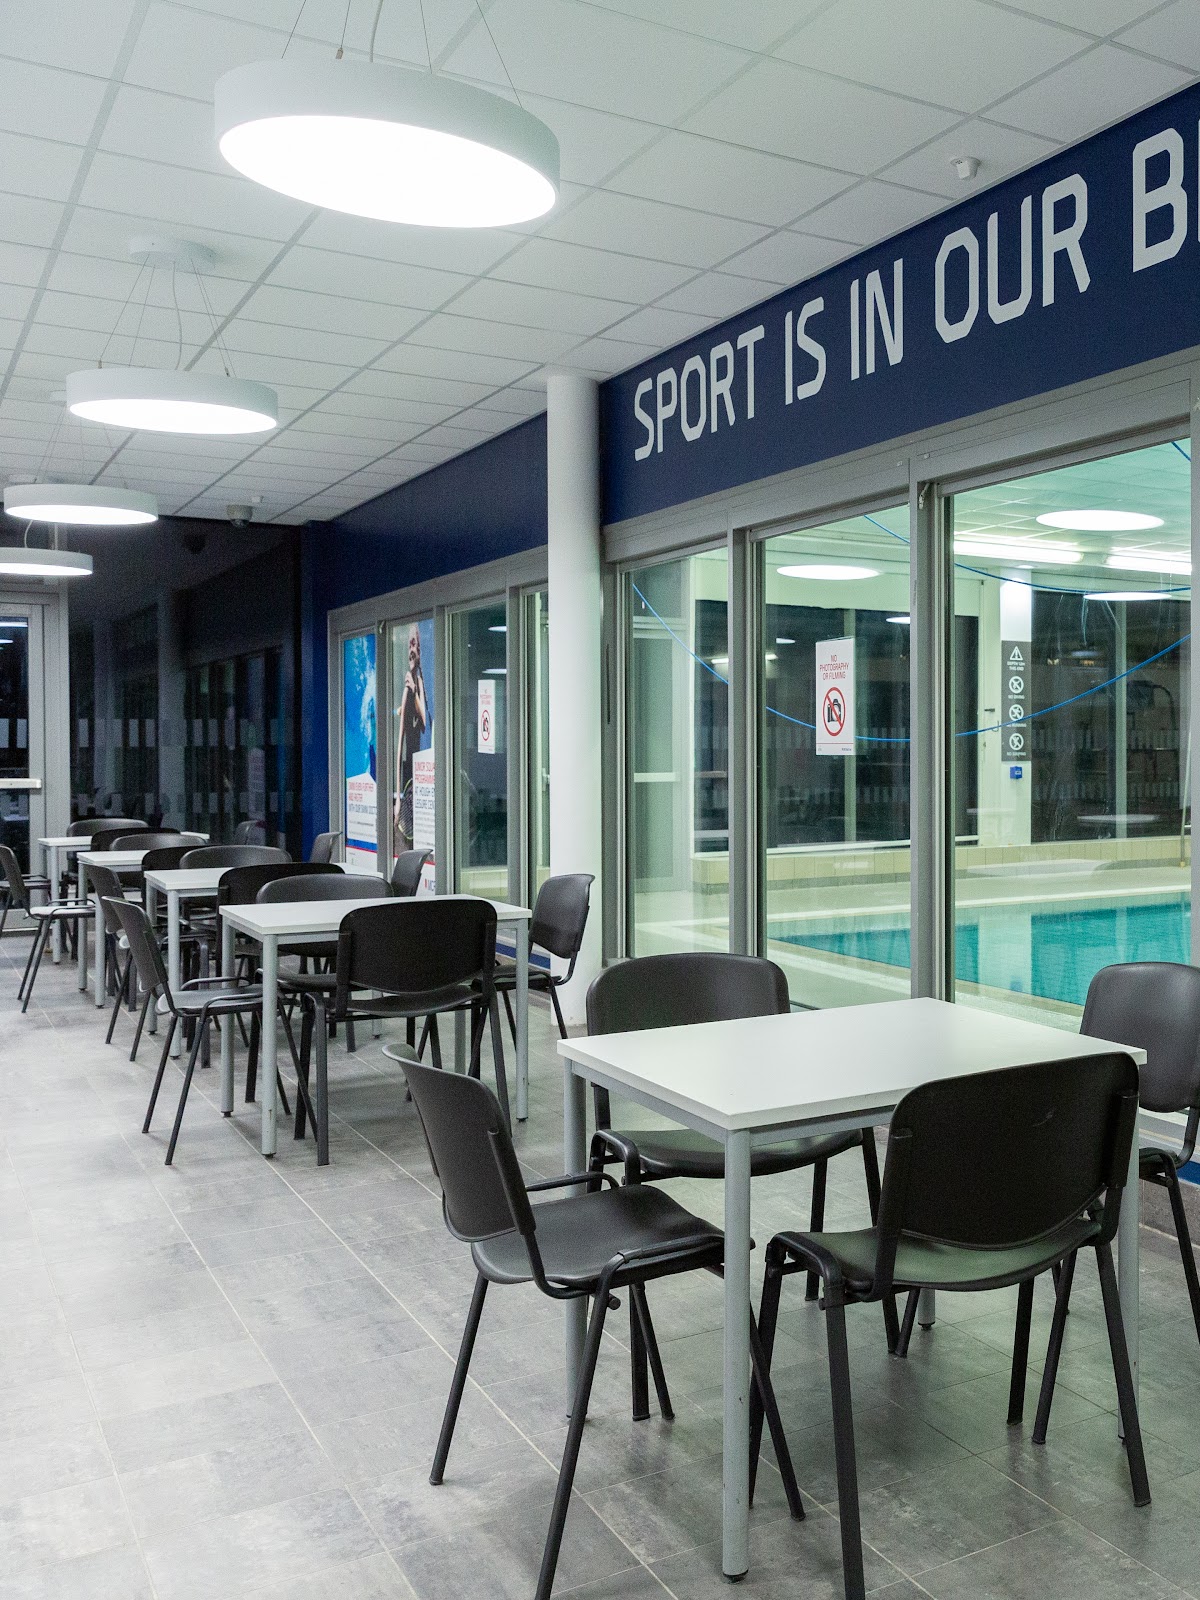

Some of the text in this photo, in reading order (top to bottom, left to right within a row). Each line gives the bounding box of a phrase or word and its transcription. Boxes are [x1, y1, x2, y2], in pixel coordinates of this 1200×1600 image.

[633, 324, 766, 462] SPORT
[784, 297, 827, 405] IS
[850, 257, 904, 381] IN
[934, 173, 1091, 344] OUR
[820, 662, 849, 671] PHOTOGRAPHY
[822, 671, 846, 680] OR FILMING
